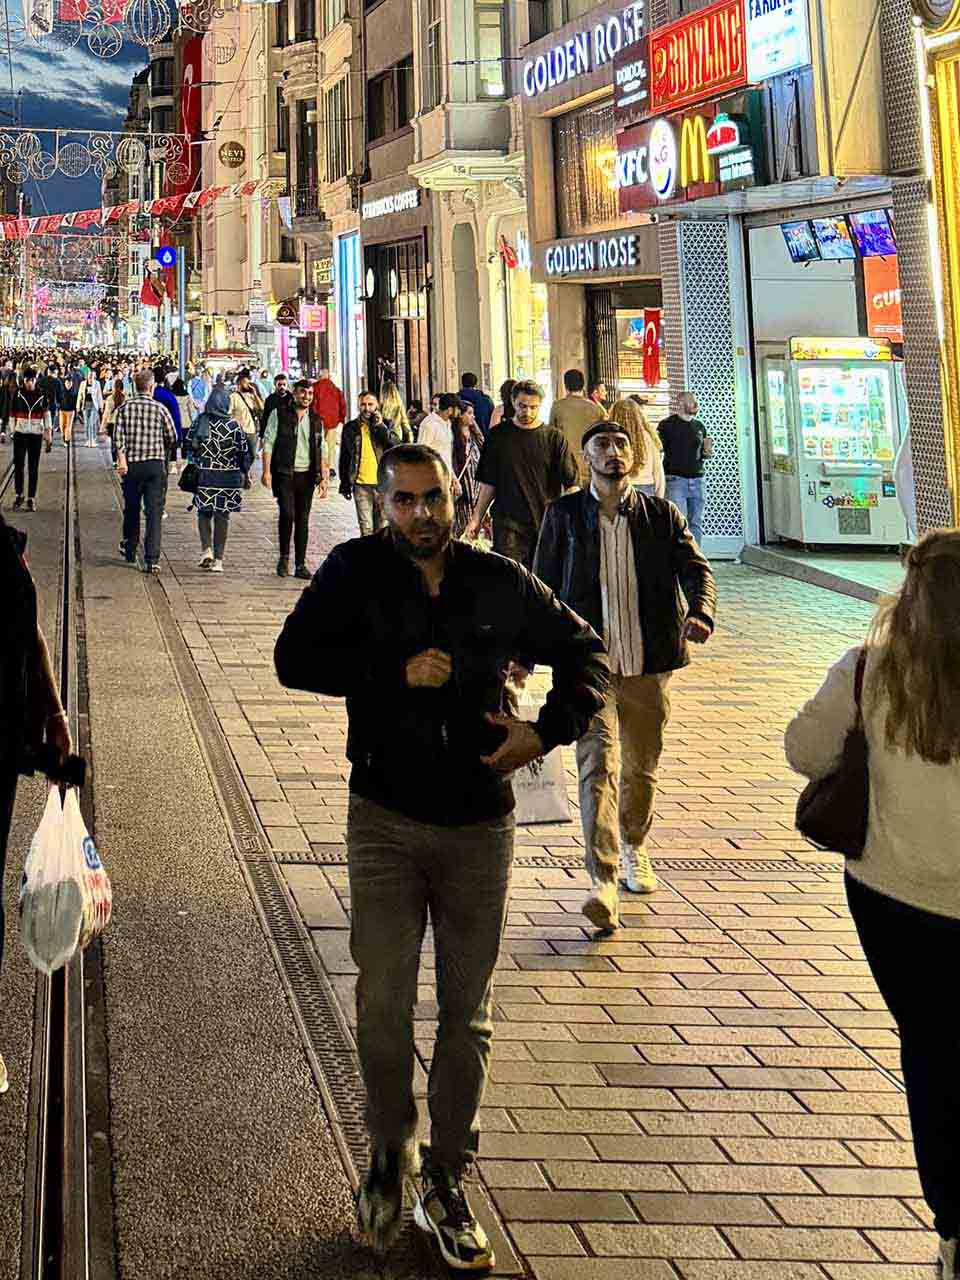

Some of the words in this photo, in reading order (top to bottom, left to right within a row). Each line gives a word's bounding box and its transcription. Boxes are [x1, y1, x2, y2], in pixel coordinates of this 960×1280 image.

[523, 29, 592, 98] GOLDEN
[668, 3, 742, 97] BOWLING
[617, 145, 647, 187] KFC
[545, 243, 594, 274] GOLDEN
[598, 235, 637, 269] ROSE
